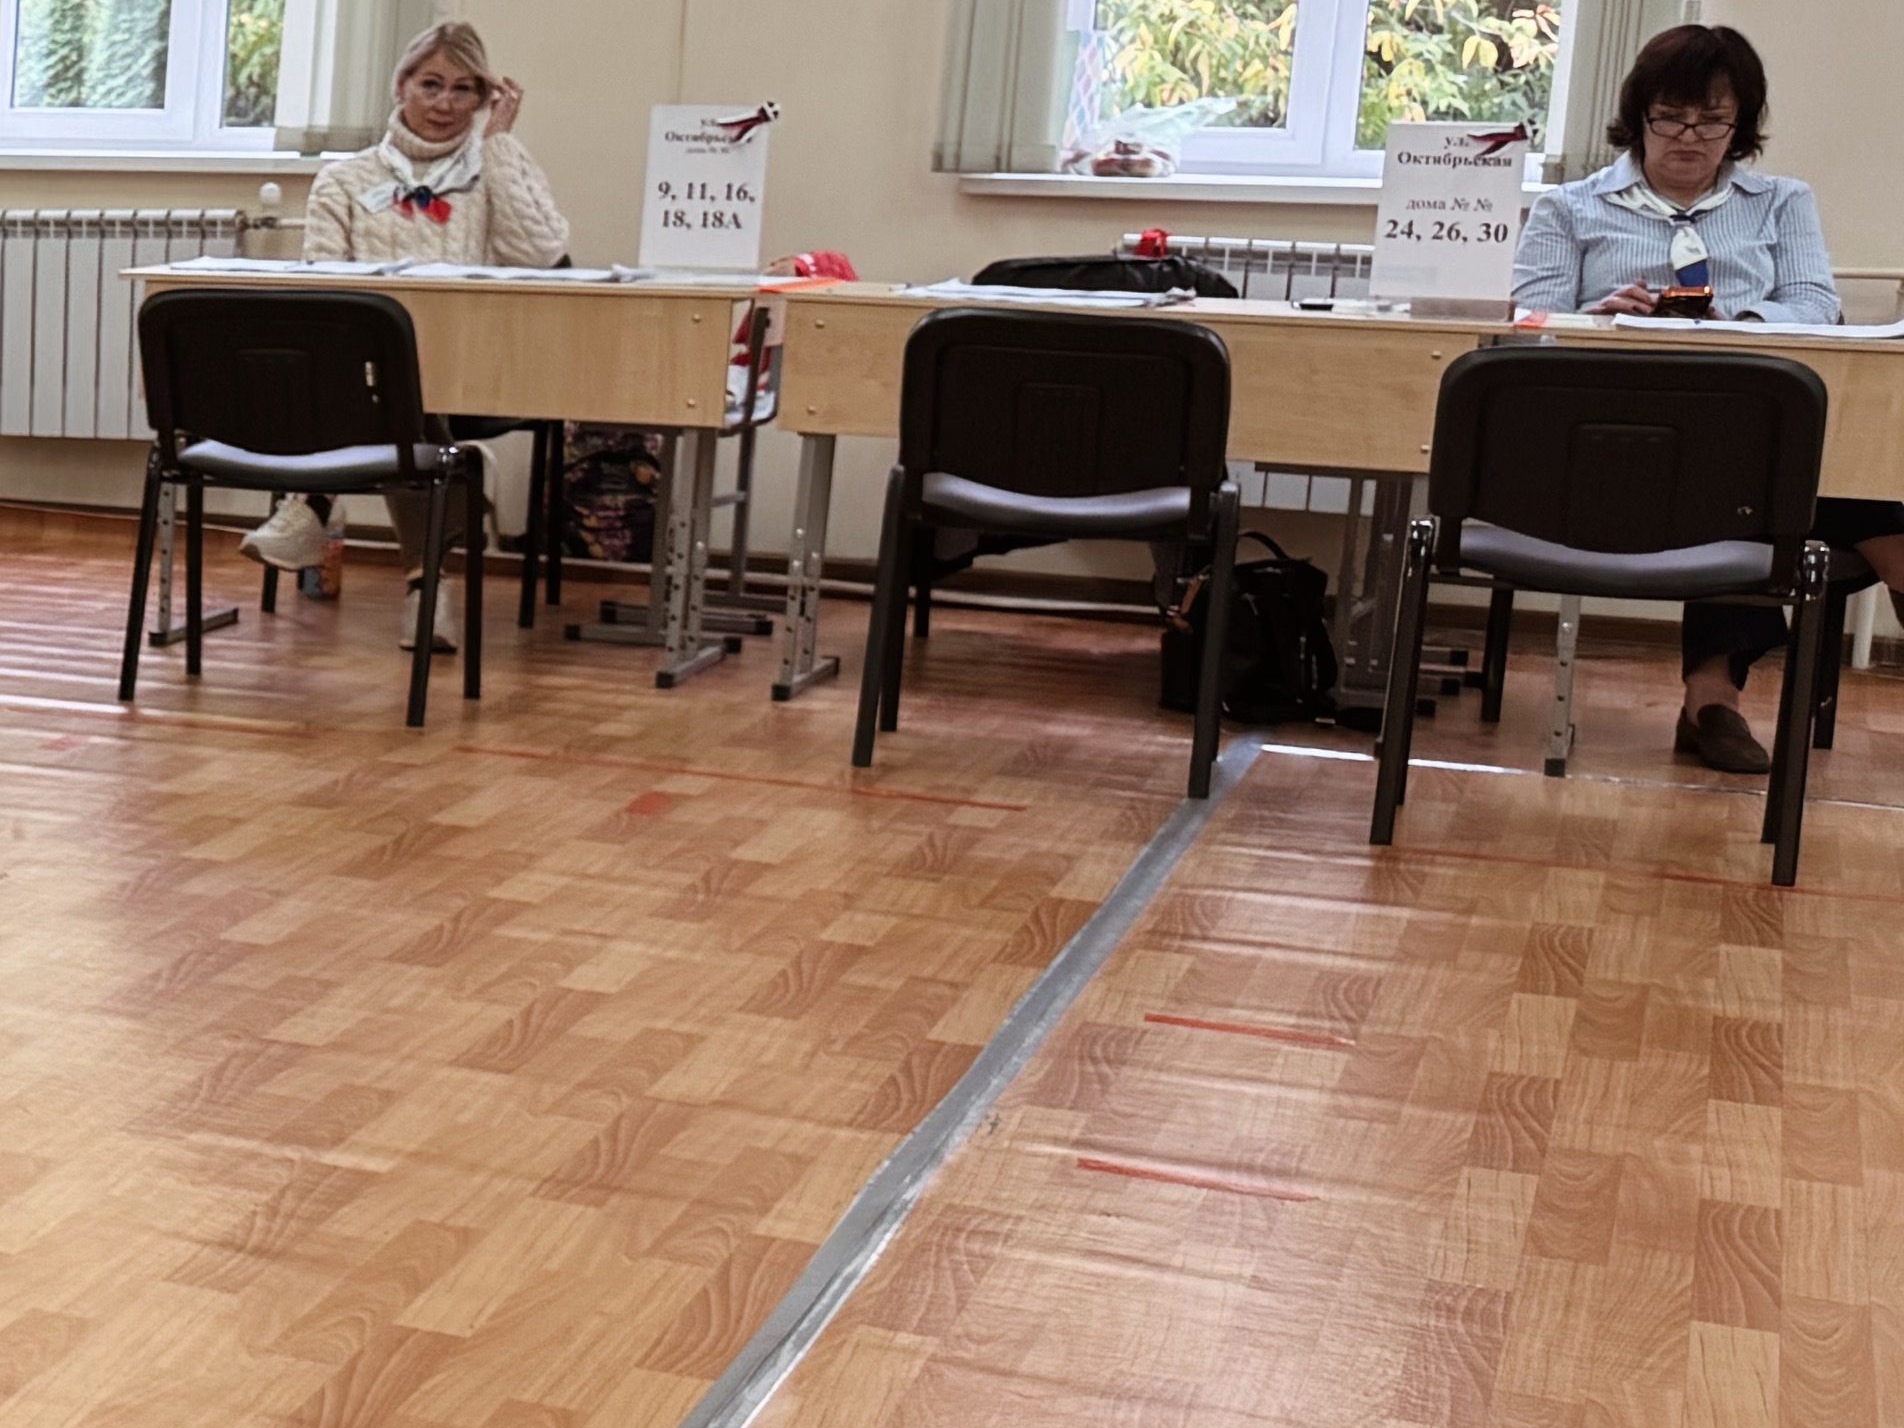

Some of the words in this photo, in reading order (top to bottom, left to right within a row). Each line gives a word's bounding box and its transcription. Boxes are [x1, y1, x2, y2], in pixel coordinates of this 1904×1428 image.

[1397, 150, 1513, 169] Октябрьская
[657, 180, 677, 201] 9,
[686, 181, 716, 202] 11,
[725, 181, 756, 203] 16,
[662, 209, 692, 230] 18,
[1384, 219, 1423, 242] 24,
[1430, 221, 1469, 243] 26,
[1476, 222, 1509, 243] 30
